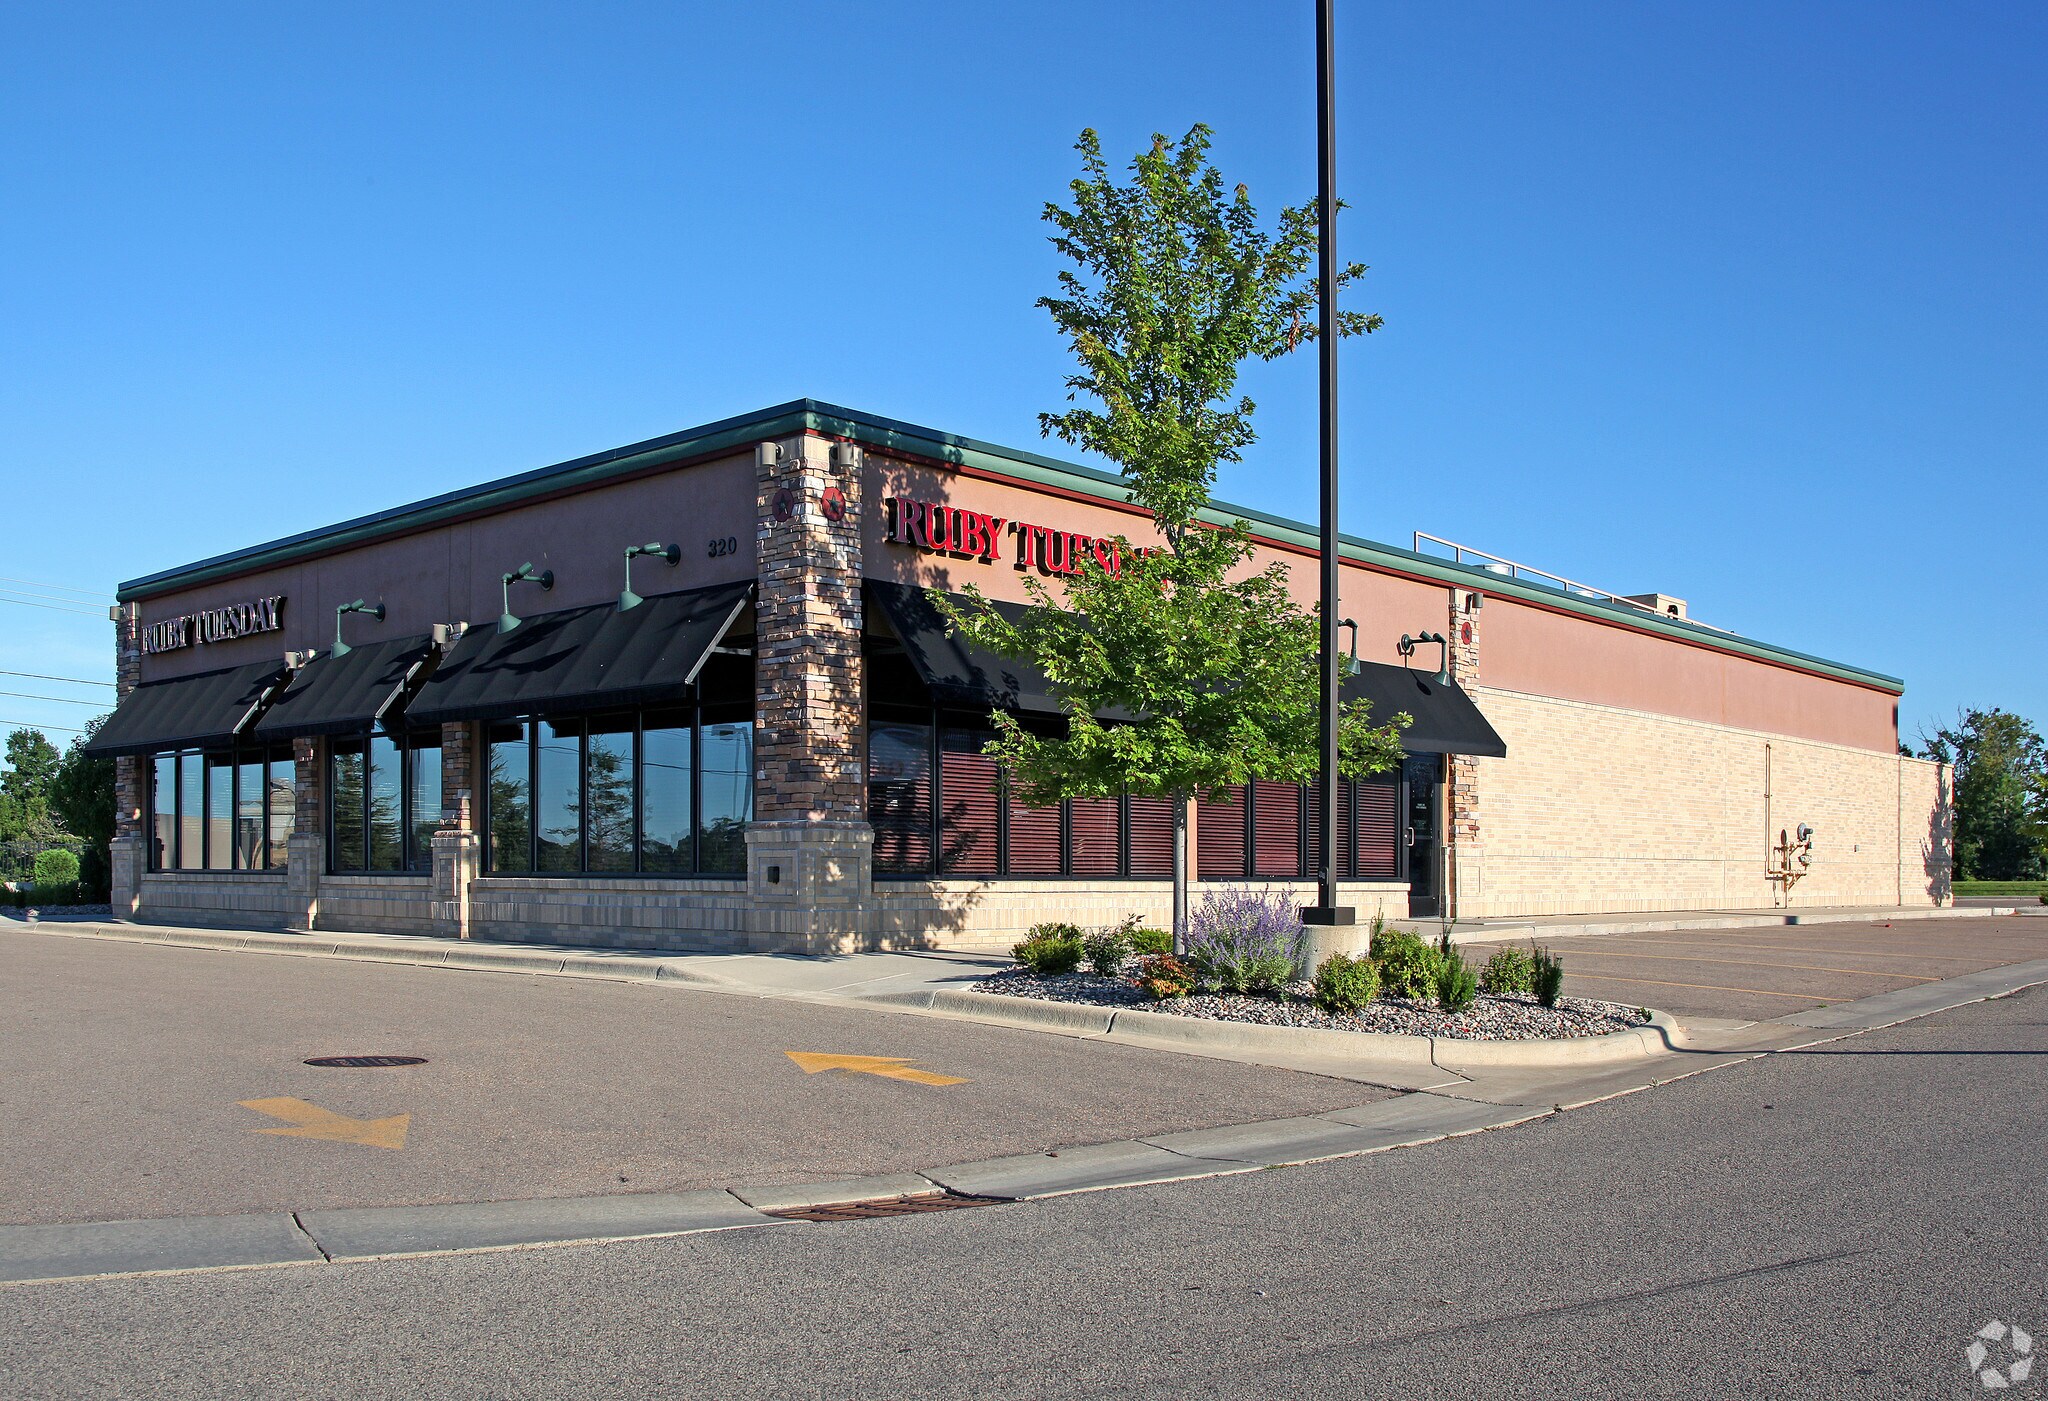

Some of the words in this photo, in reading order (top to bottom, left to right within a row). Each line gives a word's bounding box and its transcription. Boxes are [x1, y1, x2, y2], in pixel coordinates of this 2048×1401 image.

[708, 536, 737, 558] 320
[893, 496, 1007, 560] RUBY
[1013, 521, 1168, 591] TUES
[142, 616, 190, 655] RUBY
[191, 595, 284, 645] TUESDAY
